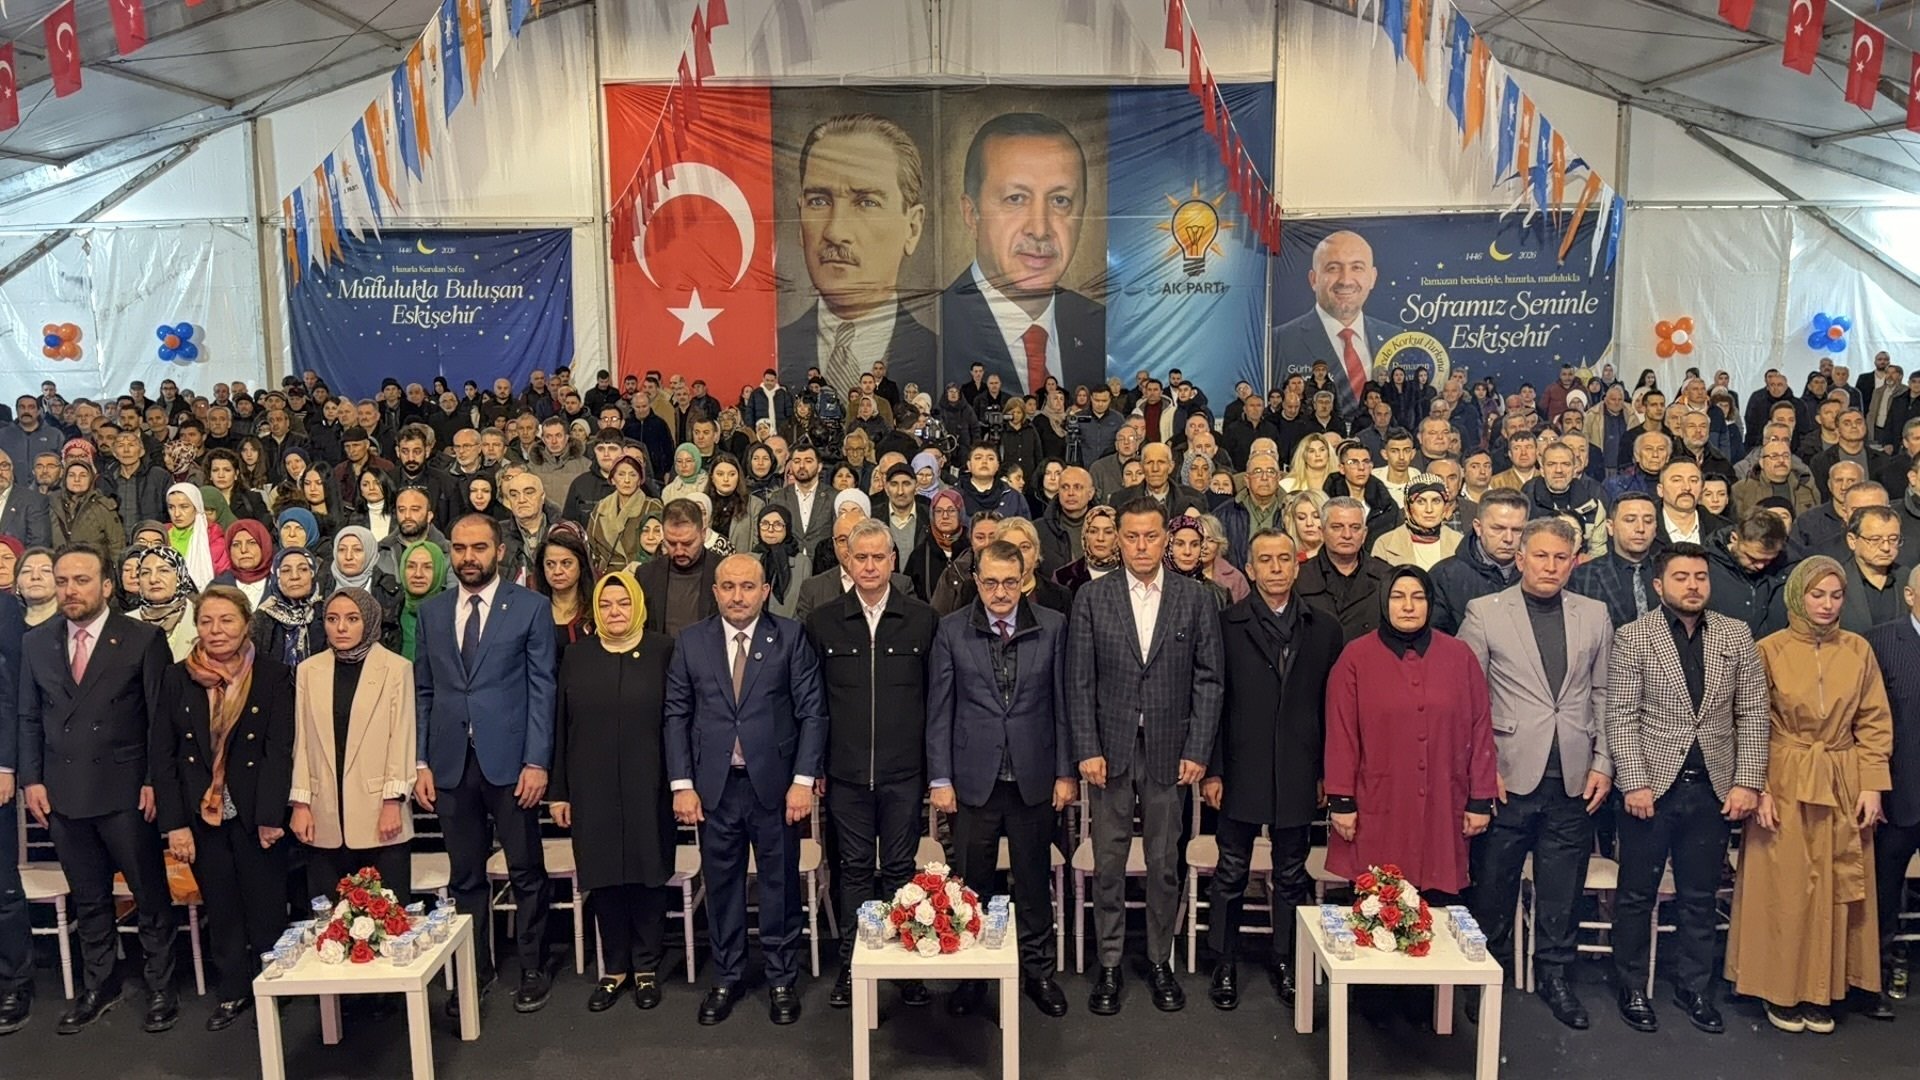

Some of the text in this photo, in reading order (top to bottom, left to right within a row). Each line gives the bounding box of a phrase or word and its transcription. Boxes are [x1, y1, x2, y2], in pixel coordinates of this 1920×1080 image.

[1518, 251, 1537, 260] 2026
[338, 275, 523, 303] Mutlulukla Buluşan
[1162, 282, 1182, 294] AK
[1421, 277, 1458, 286] Ramazan
[1538, 273, 1581, 283] mutlulukla
[391, 304, 482, 329] Eskişehir
[1400, 290, 1599, 325] Soframız Seninle
[1392, 335, 1425, 351] Korkut
[1449, 322, 1561, 353] Eskişehir
